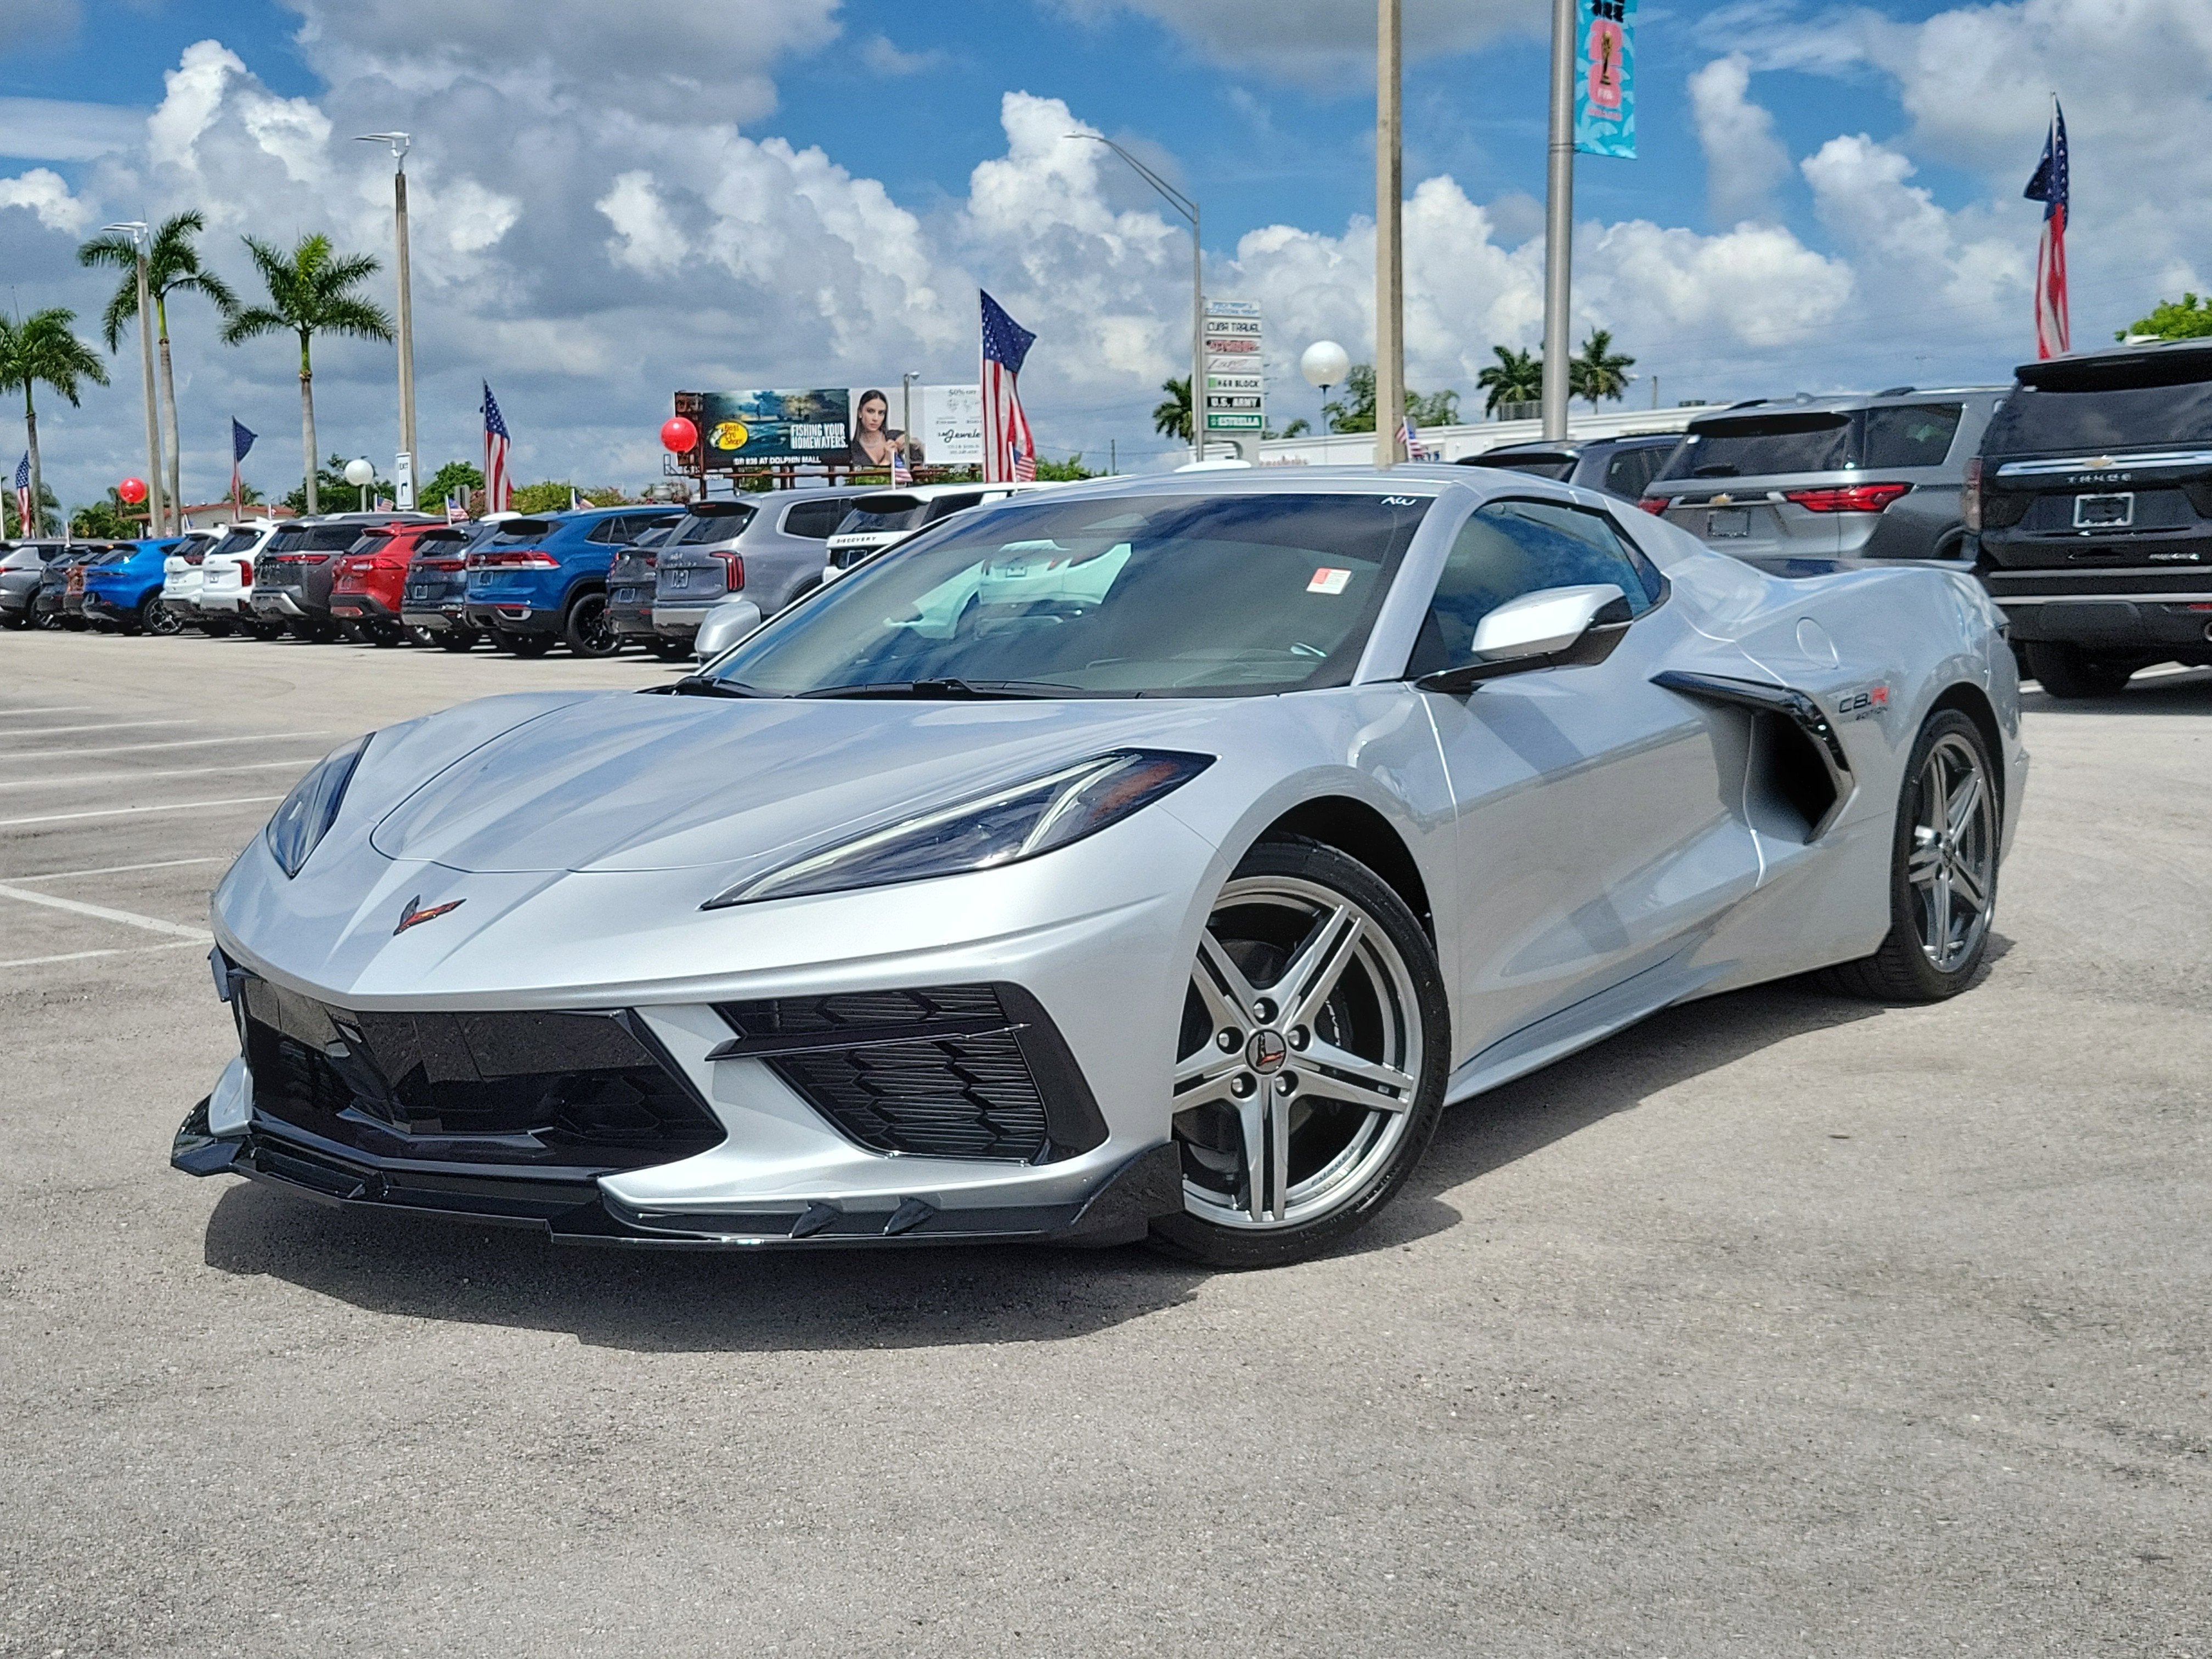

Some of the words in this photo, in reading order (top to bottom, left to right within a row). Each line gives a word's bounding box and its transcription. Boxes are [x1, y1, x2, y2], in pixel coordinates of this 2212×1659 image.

[791, 424, 822, 437] FISHING
[823, 423, 845, 437] YOUR
[791, 436, 848, 449] HOMEWATERS.
[759, 456, 768, 465] AT
[769, 456, 800, 464] DOLPHIN
